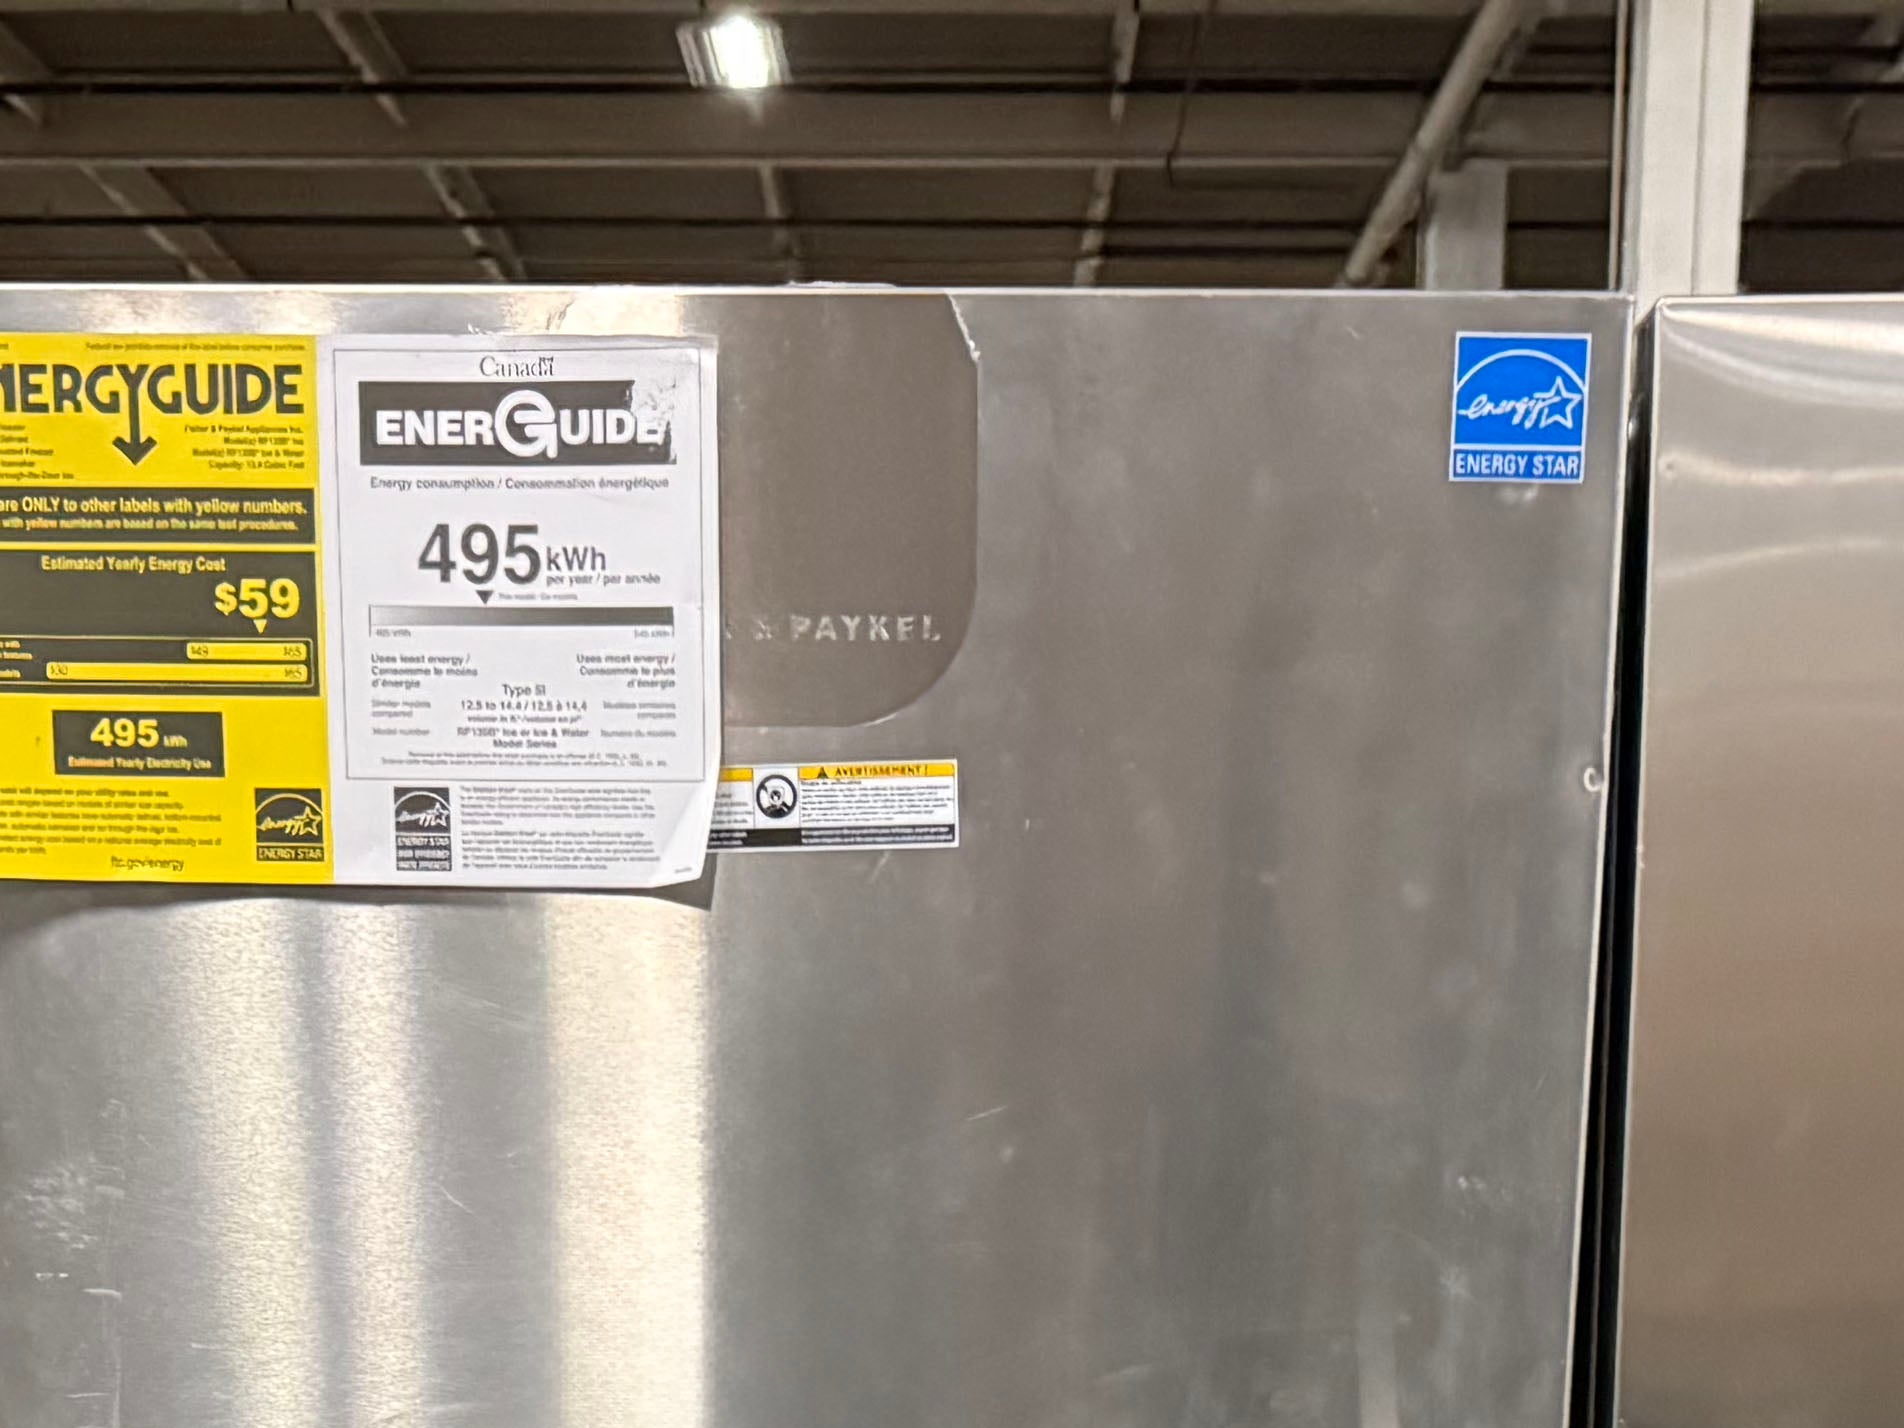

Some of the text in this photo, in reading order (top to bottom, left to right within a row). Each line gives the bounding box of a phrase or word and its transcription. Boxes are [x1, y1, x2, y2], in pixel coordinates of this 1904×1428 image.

[1455, 453, 1580, 476] ENERGY STAR
[371, 476, 669, 492] Energy consumption / Consommation énergétique
[22, 496, 61, 512] ONLY
[63, 498, 77, 512] to
[80, 497, 116, 513] other
[119, 498, 161, 513] labels
[164, 498, 192, 513] with
[195, 498, 240, 517] yellow
[243, 499, 308, 515] numbers.
[2, 517, 24, 529] with
[26, 517, 57, 531] yellow
[60, 517, 103, 529] numbers
[106, 519, 121, 529] are
[123, 518, 154, 529] based
[155, 521, 169, 529] on
[171, 518, 187, 529] the
[189, 520, 216, 530] same
[218, 519, 237, 530] test
[418, 523, 607, 585] 495 kWh
[41, 555, 226, 575] Estimated Yearly Energy Cost
[214, 578, 300, 619] $59
[789, 614, 942, 642] PAYKEL
[371, 653, 397, 664] Uses
[427, 655, 464, 666] energy
[502, 683, 532, 698] Type
[90, 717, 188, 748] 495 kWh
[68, 755, 212, 771] Estimated Yearly Electricity Use
